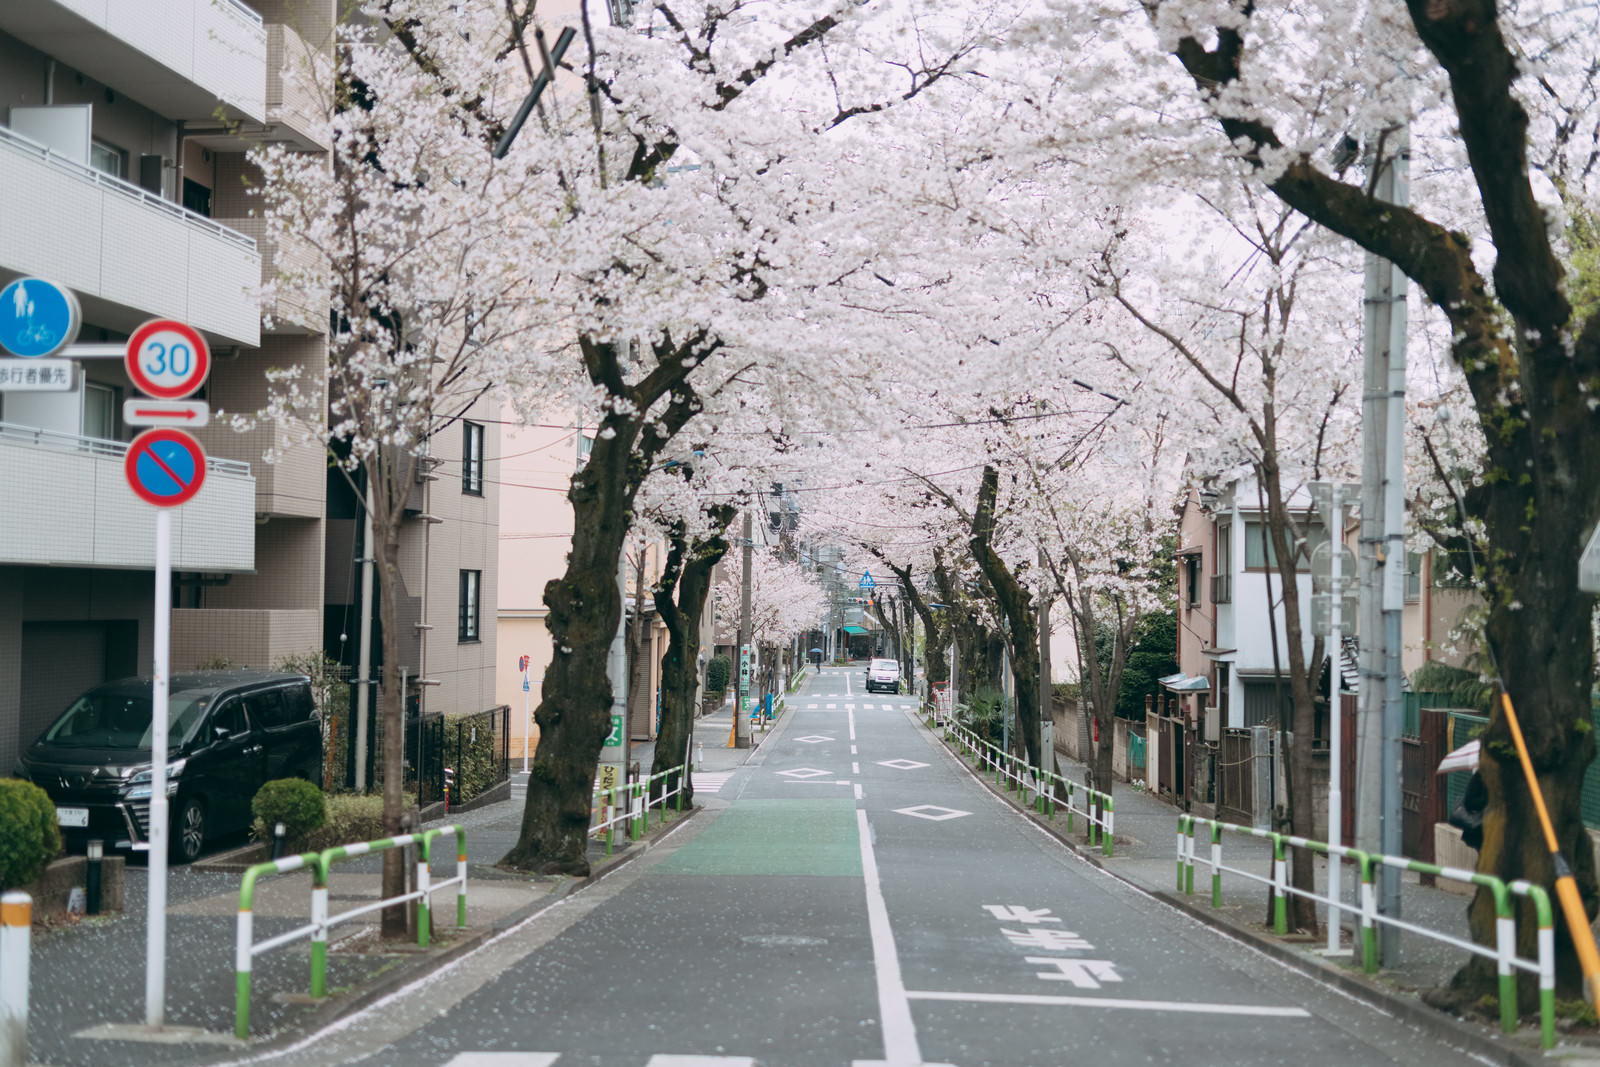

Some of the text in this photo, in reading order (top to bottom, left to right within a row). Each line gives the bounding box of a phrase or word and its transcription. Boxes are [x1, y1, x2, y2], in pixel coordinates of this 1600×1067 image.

[146, 342, 189, 376] 30
[0, 366, 67, 385] 歩行者優先
[603, 765, 614, 794] ひったく
[981, 904, 1124, 989] 止まれ
